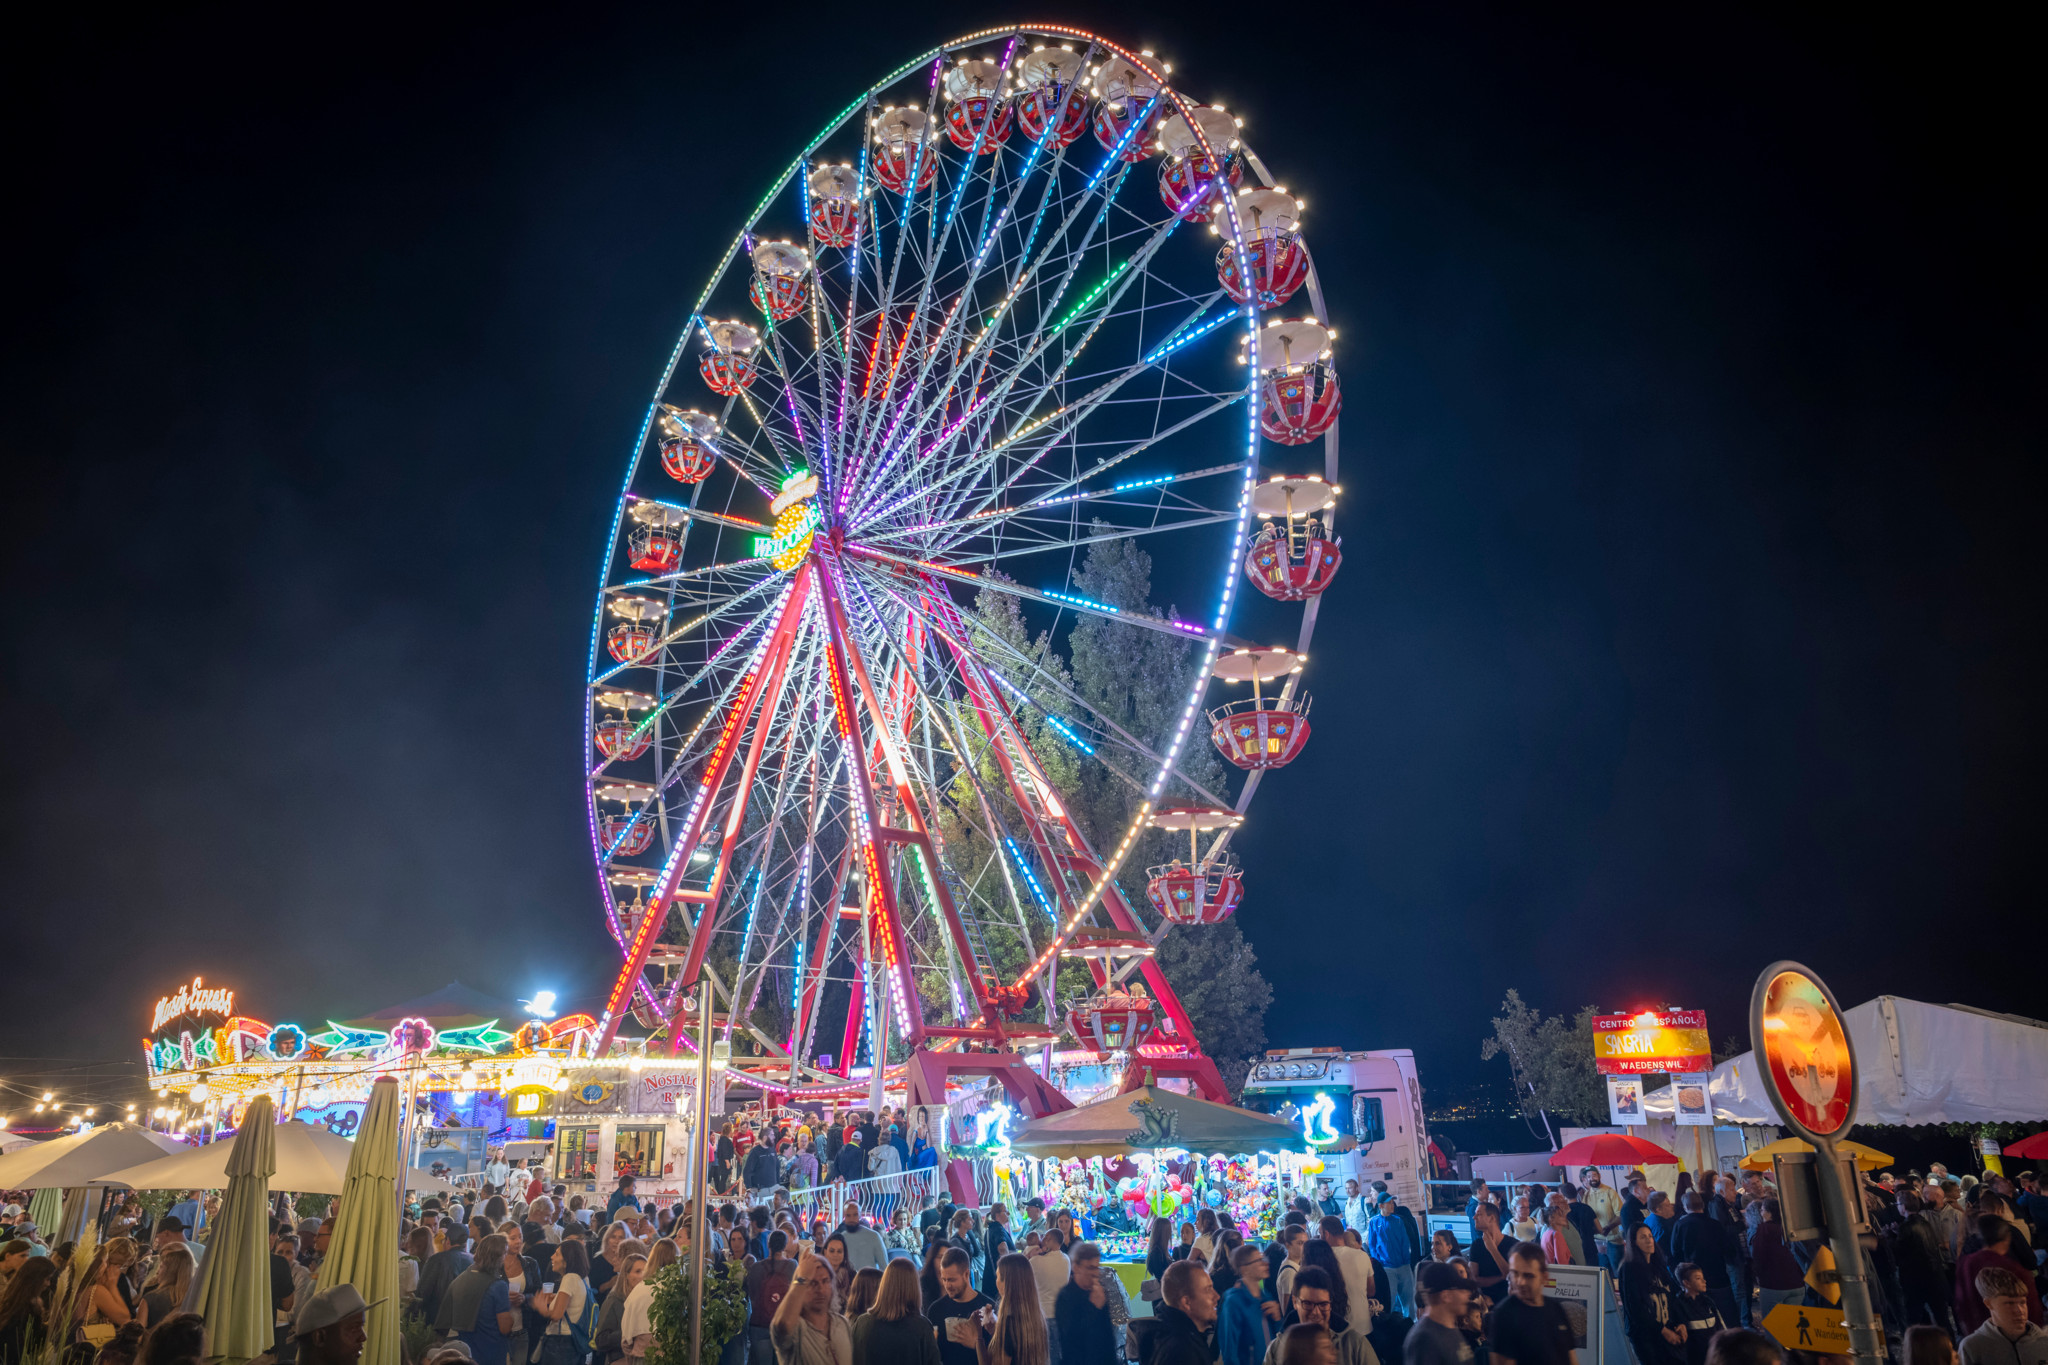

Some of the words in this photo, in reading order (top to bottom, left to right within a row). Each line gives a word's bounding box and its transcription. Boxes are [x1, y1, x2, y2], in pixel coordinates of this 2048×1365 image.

[753, 503, 822, 558] WELCOME
[1599, 1019, 1635, 1029] CENTRO
[1653, 1015, 1697, 1027] ESPAÑOL
[1619, 1060, 1683, 1070] WAEDENSWIL
[1407, 1076, 1431, 1193] ACTROS
[1554, 1287, 1580, 1297] PAELLA
